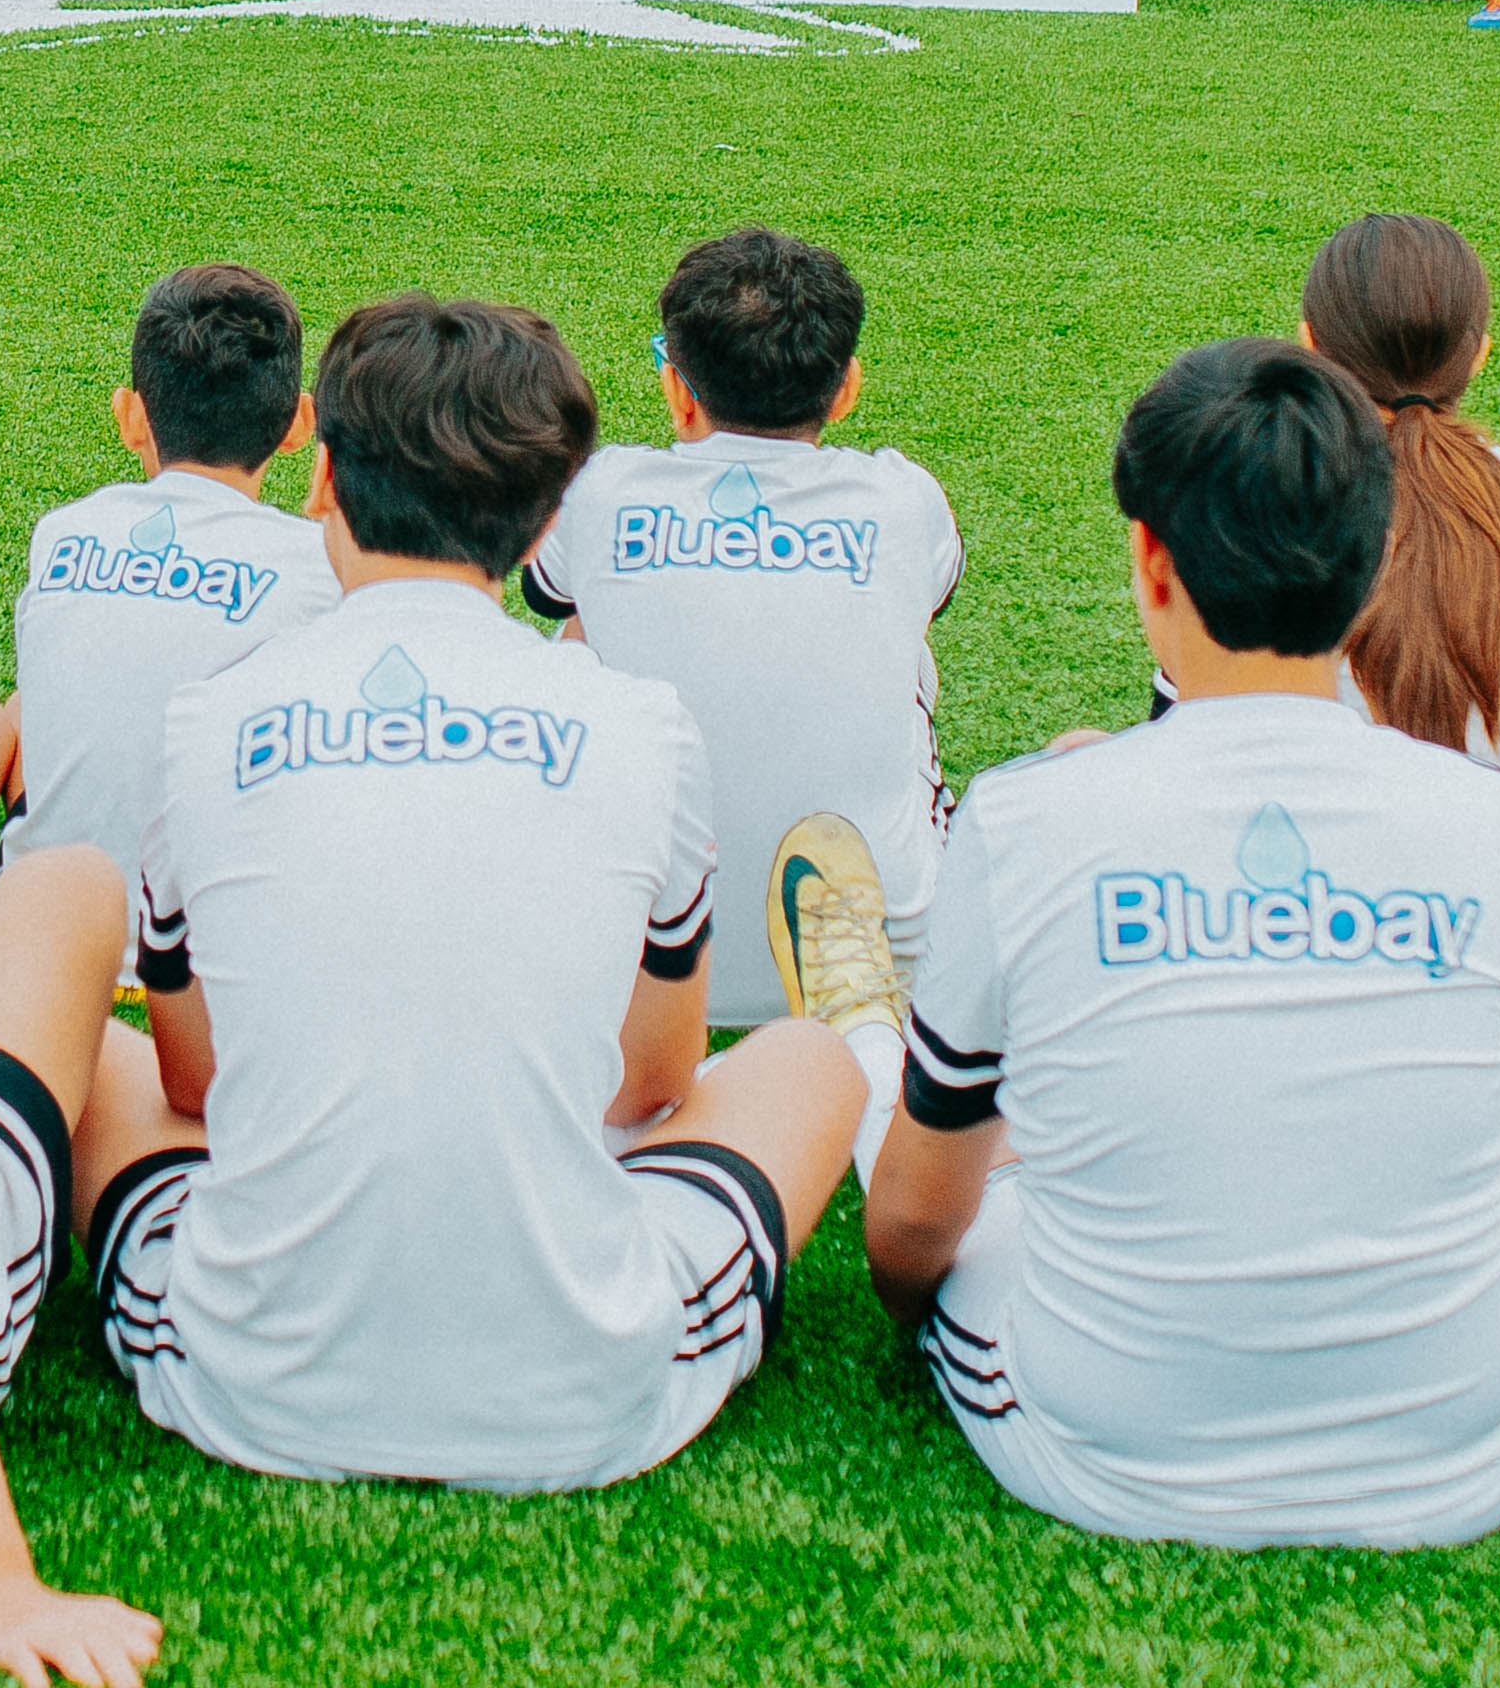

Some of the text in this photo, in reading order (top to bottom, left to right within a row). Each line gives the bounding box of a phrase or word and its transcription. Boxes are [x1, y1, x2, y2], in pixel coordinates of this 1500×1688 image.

[38, 534, 278, 623] Bluebay
[613, 504, 880, 585] Bluebay
[236, 696, 587, 789] Bluebay
[1096, 869, 1482, 980] Bluebay
